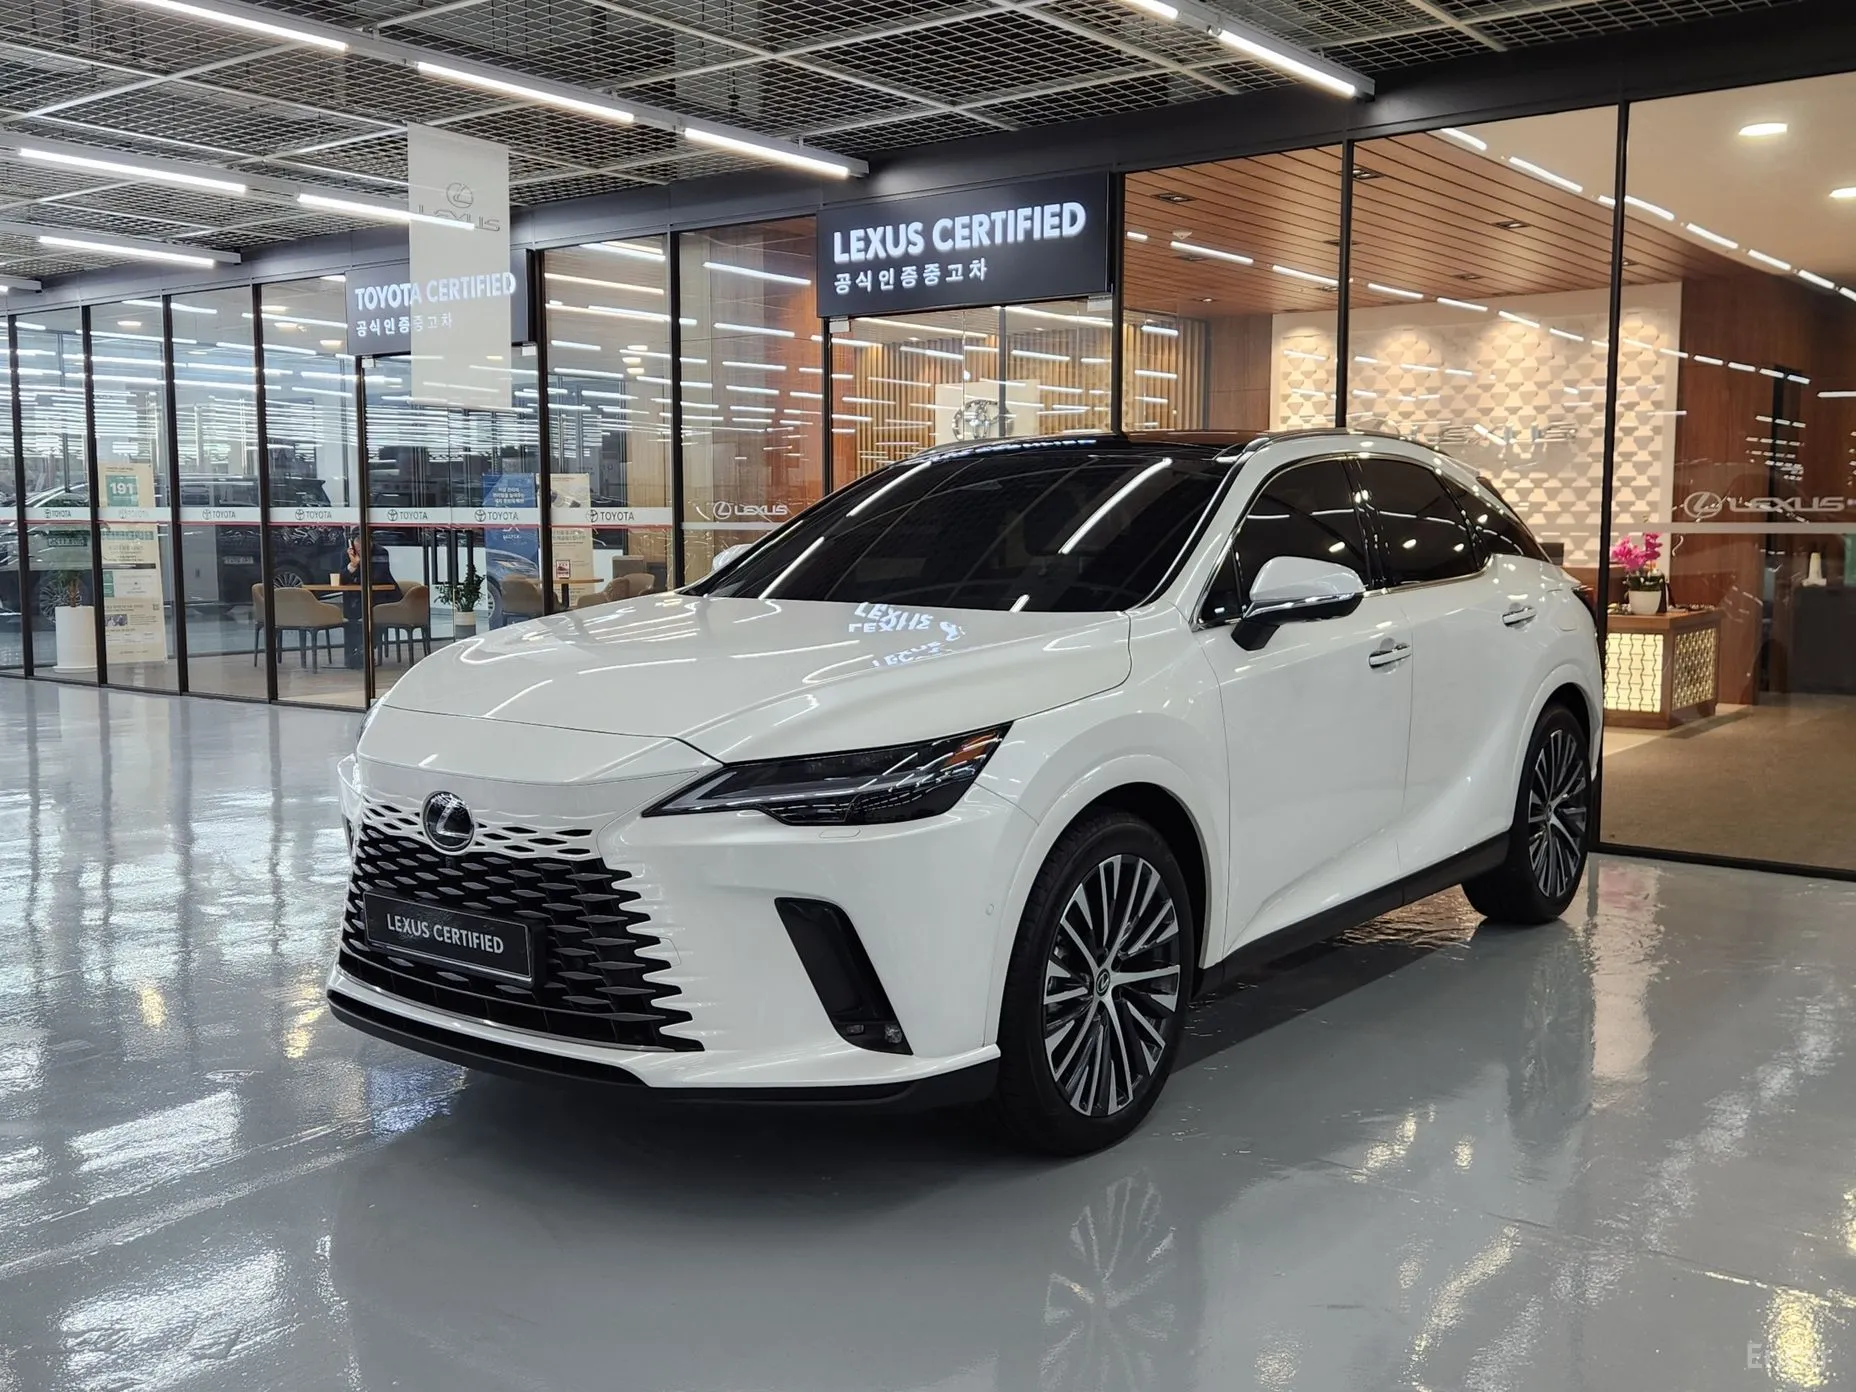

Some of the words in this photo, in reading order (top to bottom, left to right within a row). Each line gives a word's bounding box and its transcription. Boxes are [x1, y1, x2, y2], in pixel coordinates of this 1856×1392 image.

[833, 221, 925, 264] LEXUS
[932, 201, 1087, 253] CERTIFIED
[834, 257, 988, 295] 공식인증중고차
[354, 281, 422, 312] TOYOTA
[426, 271, 517, 303] CERTIFIED
[110, 483, 134, 495] 191
[734, 504, 788, 516] LEXUS
[1729, 496, 1845, 513] LEXUS
[212, 510, 236, 519] TOYOTA
[305, 510, 332, 519] TOYOTA
[400, 511, 428, 520] TOYOTA
[488, 511, 519, 521] TOYOTA
[600, 511, 635, 521] TOYOTA
[386, 913, 430, 938] LEXUS
[433, 924, 504, 954] CERTIFIED
